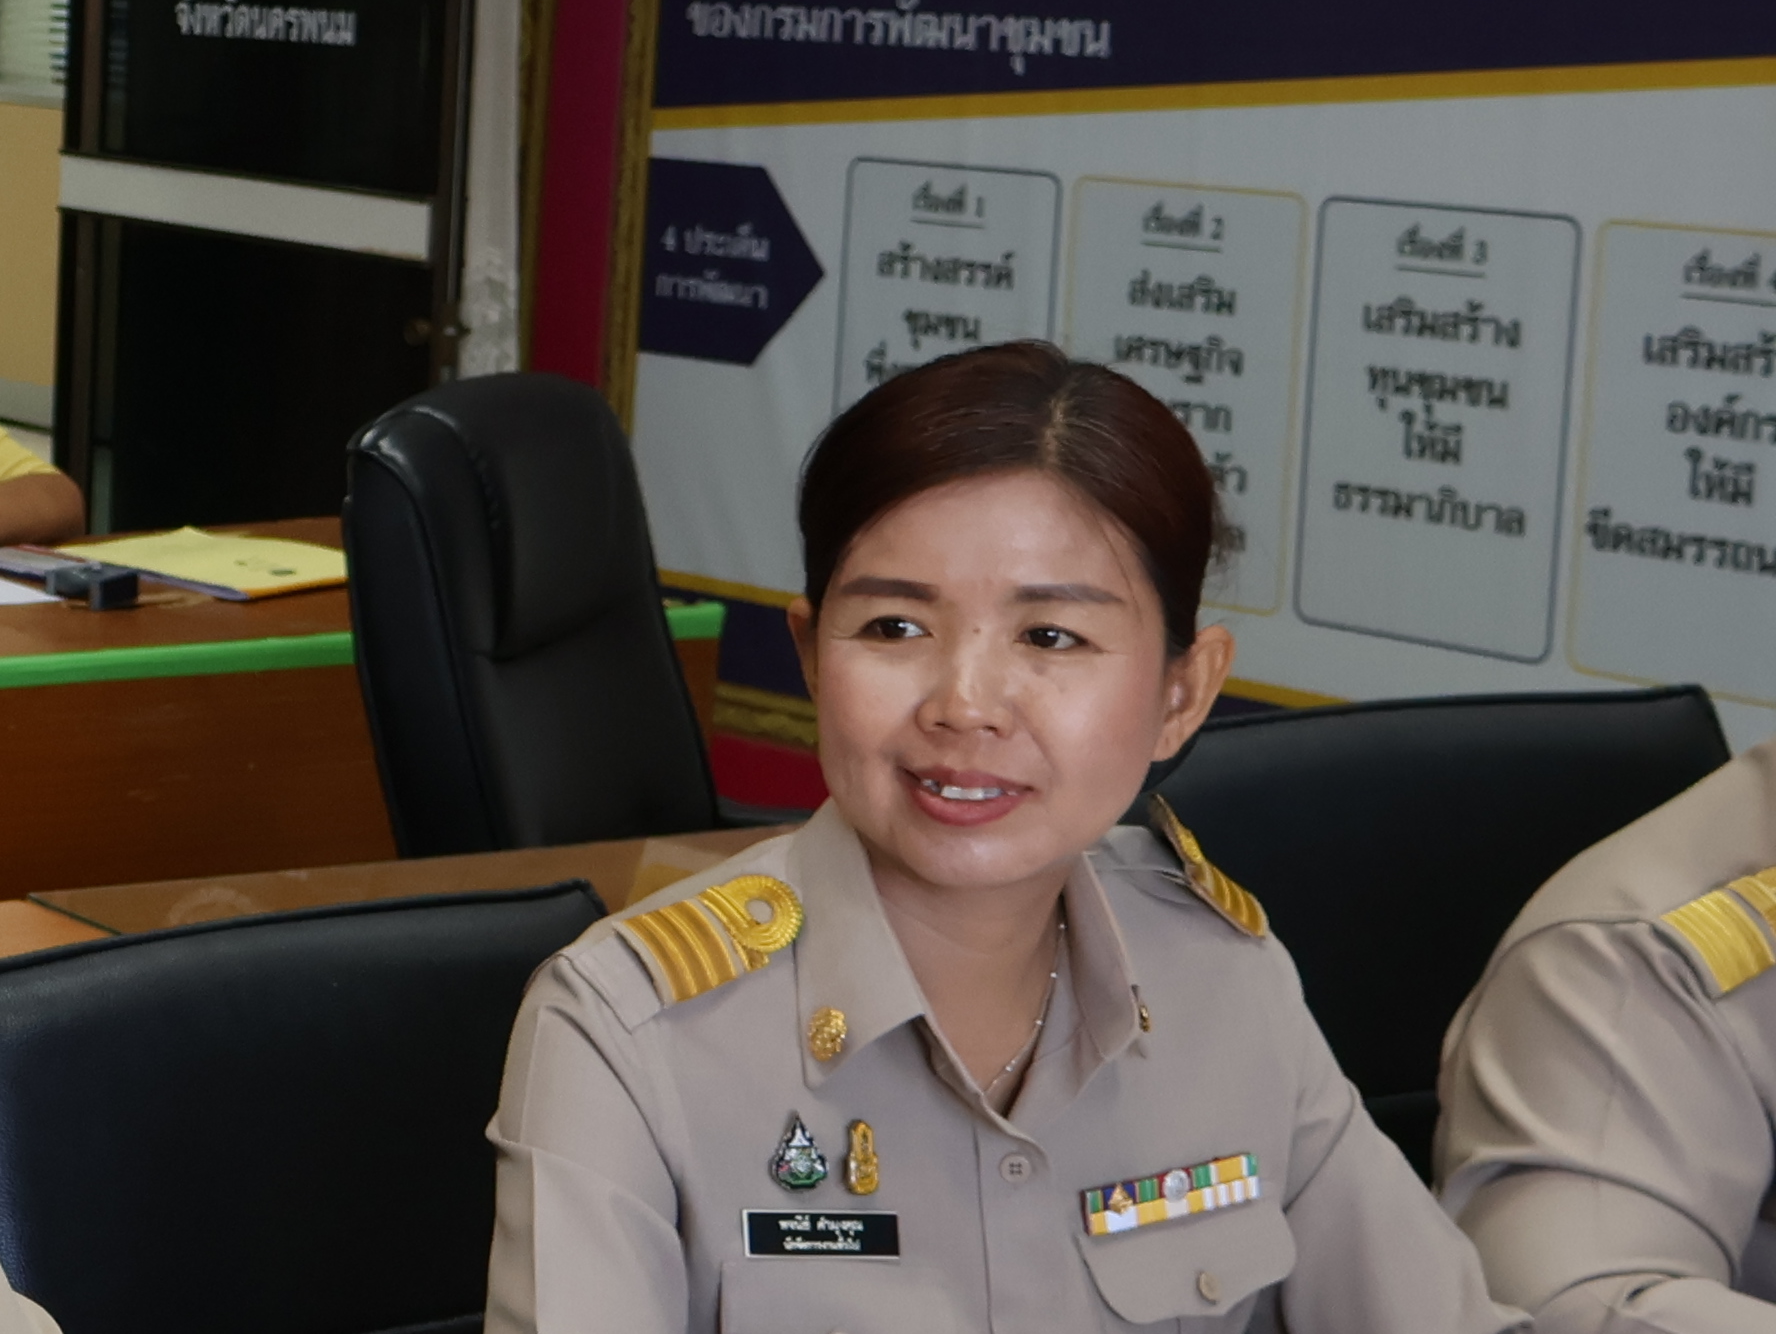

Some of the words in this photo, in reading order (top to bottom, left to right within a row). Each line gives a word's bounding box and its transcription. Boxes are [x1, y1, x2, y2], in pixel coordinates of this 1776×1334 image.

[659, 223, 679, 253] 4
[1210, 216, 1225, 241] 2
[1472, 239, 1489, 265] 3
[876, 240, 1017, 292] สร้างสรรค์
[1127, 268, 1238, 317] ส่งเสริม
[902, 307, 982, 350] ชุมชน
[1361, 293, 1522, 349] เสริมสร้าง
[1113, 333, 1246, 386] เศรษฐกิจ
[1642, 324, 1776, 379] เสริมสร้
[1398, 409, 1464, 466] ให้มี
[1332, 479, 1527, 537] ธรรมาภิบาล
